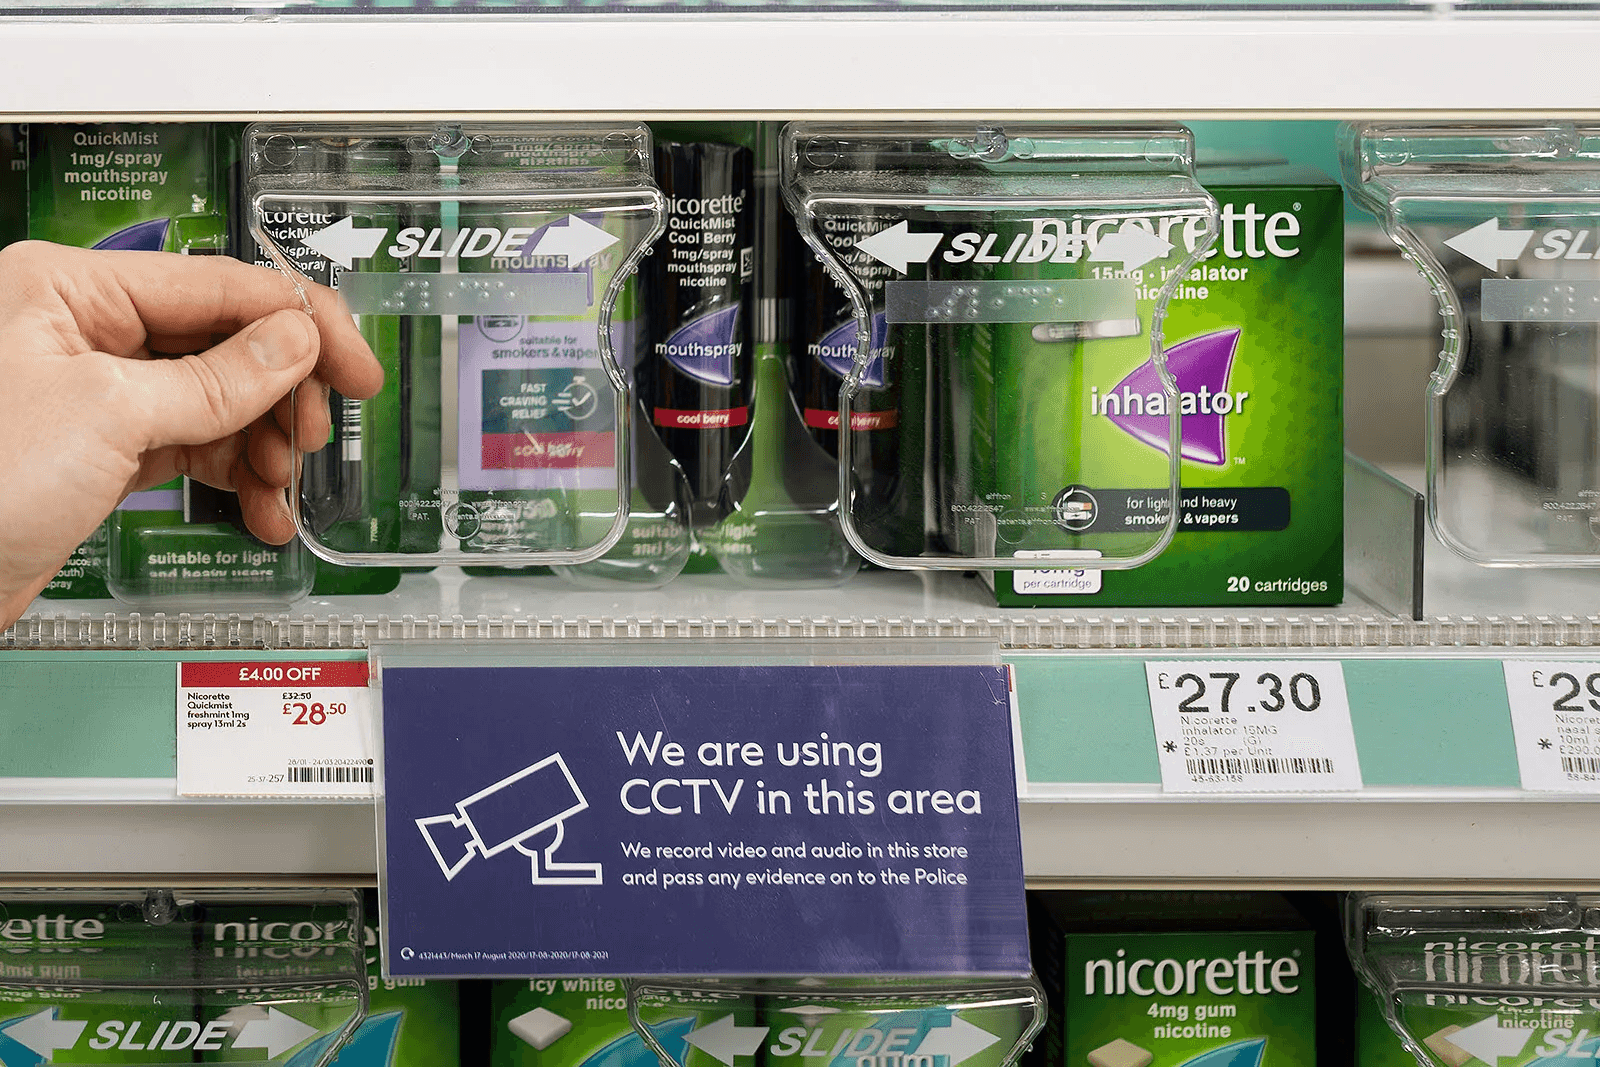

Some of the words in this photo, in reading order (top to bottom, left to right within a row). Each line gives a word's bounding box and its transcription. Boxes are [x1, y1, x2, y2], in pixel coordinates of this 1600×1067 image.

[73, 131, 159, 146] QuickMist
[69, 151, 163, 167] 1mg/spray
[63, 169, 168, 185] mouthspray
[80, 187, 153, 201] nicotine
[669, 217, 736, 230] QuickMist
[388, 227, 536, 258] SLIDE
[668, 232, 700, 244] Cool
[703, 232, 736, 245] Berry
[1534, 229, 1600, 259] SL
[671, 249, 734, 261] 1mg/spray
[943, 233, 1092, 264] SLIDE
[667, 262, 737, 275] mouthspray
[679, 276, 727, 287] nicotine
[655, 342, 742, 359] mouthspray
[520, 383, 547, 393] FAST
[1091, 385, 1249, 416] inhaator
[677, 414, 701, 425] cool
[702, 413, 730, 425] berry
[1126, 496, 1144, 509] for
[1202, 495, 1238, 511] heavy
[1183, 512, 1194, 524] &
[1194, 513, 1240, 526] vapers
[147, 551, 212, 565] suitable
[215, 550, 239, 564] for
[242, 550, 279, 567] light
[1043, 578, 1092, 591] cartridge
[1226, 576, 1251, 593] 20
[1254, 577, 1328, 595] cartridges
[238, 667, 284, 681] £4.00
[286, 667, 322, 681] OFF
[187, 692, 231, 701] Nicorette
[1158, 672, 1322, 713] £27.30
[187, 701, 233, 711] Quickmist
[282, 702, 347, 726] £28.50
[187, 710, 230, 719] freshmint
[231, 710, 250, 721] 1mg
[1180, 715, 1238, 725] Nicorette
[187, 720, 213, 730] spray
[214, 719, 235, 728] 13ml
[236, 719, 247, 728] 2s
[1181, 726, 1238, 736] inhalator
[1183, 736, 1206, 746] 20s
[616, 731, 684, 766] We
[698, 742, 763, 767] are
[777, 731, 882, 777] using
[1223, 748, 1244, 757] per
[1247, 746, 1273, 755] Unit
[620, 779, 744, 815] CCTV
[757, 780, 791, 815] in
[804, 779, 877, 815] this
[887, 790, 982, 815] area
[621, 842, 651, 859] We
[655, 842, 713, 859] record
[718, 841, 767, 859] video
[771, 842, 806, 859] and
[811, 841, 862, 859] audio
[866, 841, 883, 859] in
[887, 841, 919, 859] this
[923, 844, 969, 859] store
[622, 868, 658, 886] and
[663, 872, 704, 890] pass
[707, 872, 742, 890] any
[746, 868, 826, 885] evidence
[830, 872, 853, 885] on
[856, 870, 876, 885] to
[879, 868, 911, 885] the
[915, 868, 968, 885] Police
[1085, 949, 1300, 996] nicorette
[529, 978, 557, 995] icy
[562, 978, 616, 992] white
[1147, 1003, 1189, 1021] 4mg
[1195, 1005, 1237, 1021] gum
[88, 1020, 235, 1050] SLIDE
[1153, 1023, 1232, 1038] nicotine
[770, 1027, 918, 1057] SLIDE
[1535, 1028, 1600, 1058] SL
